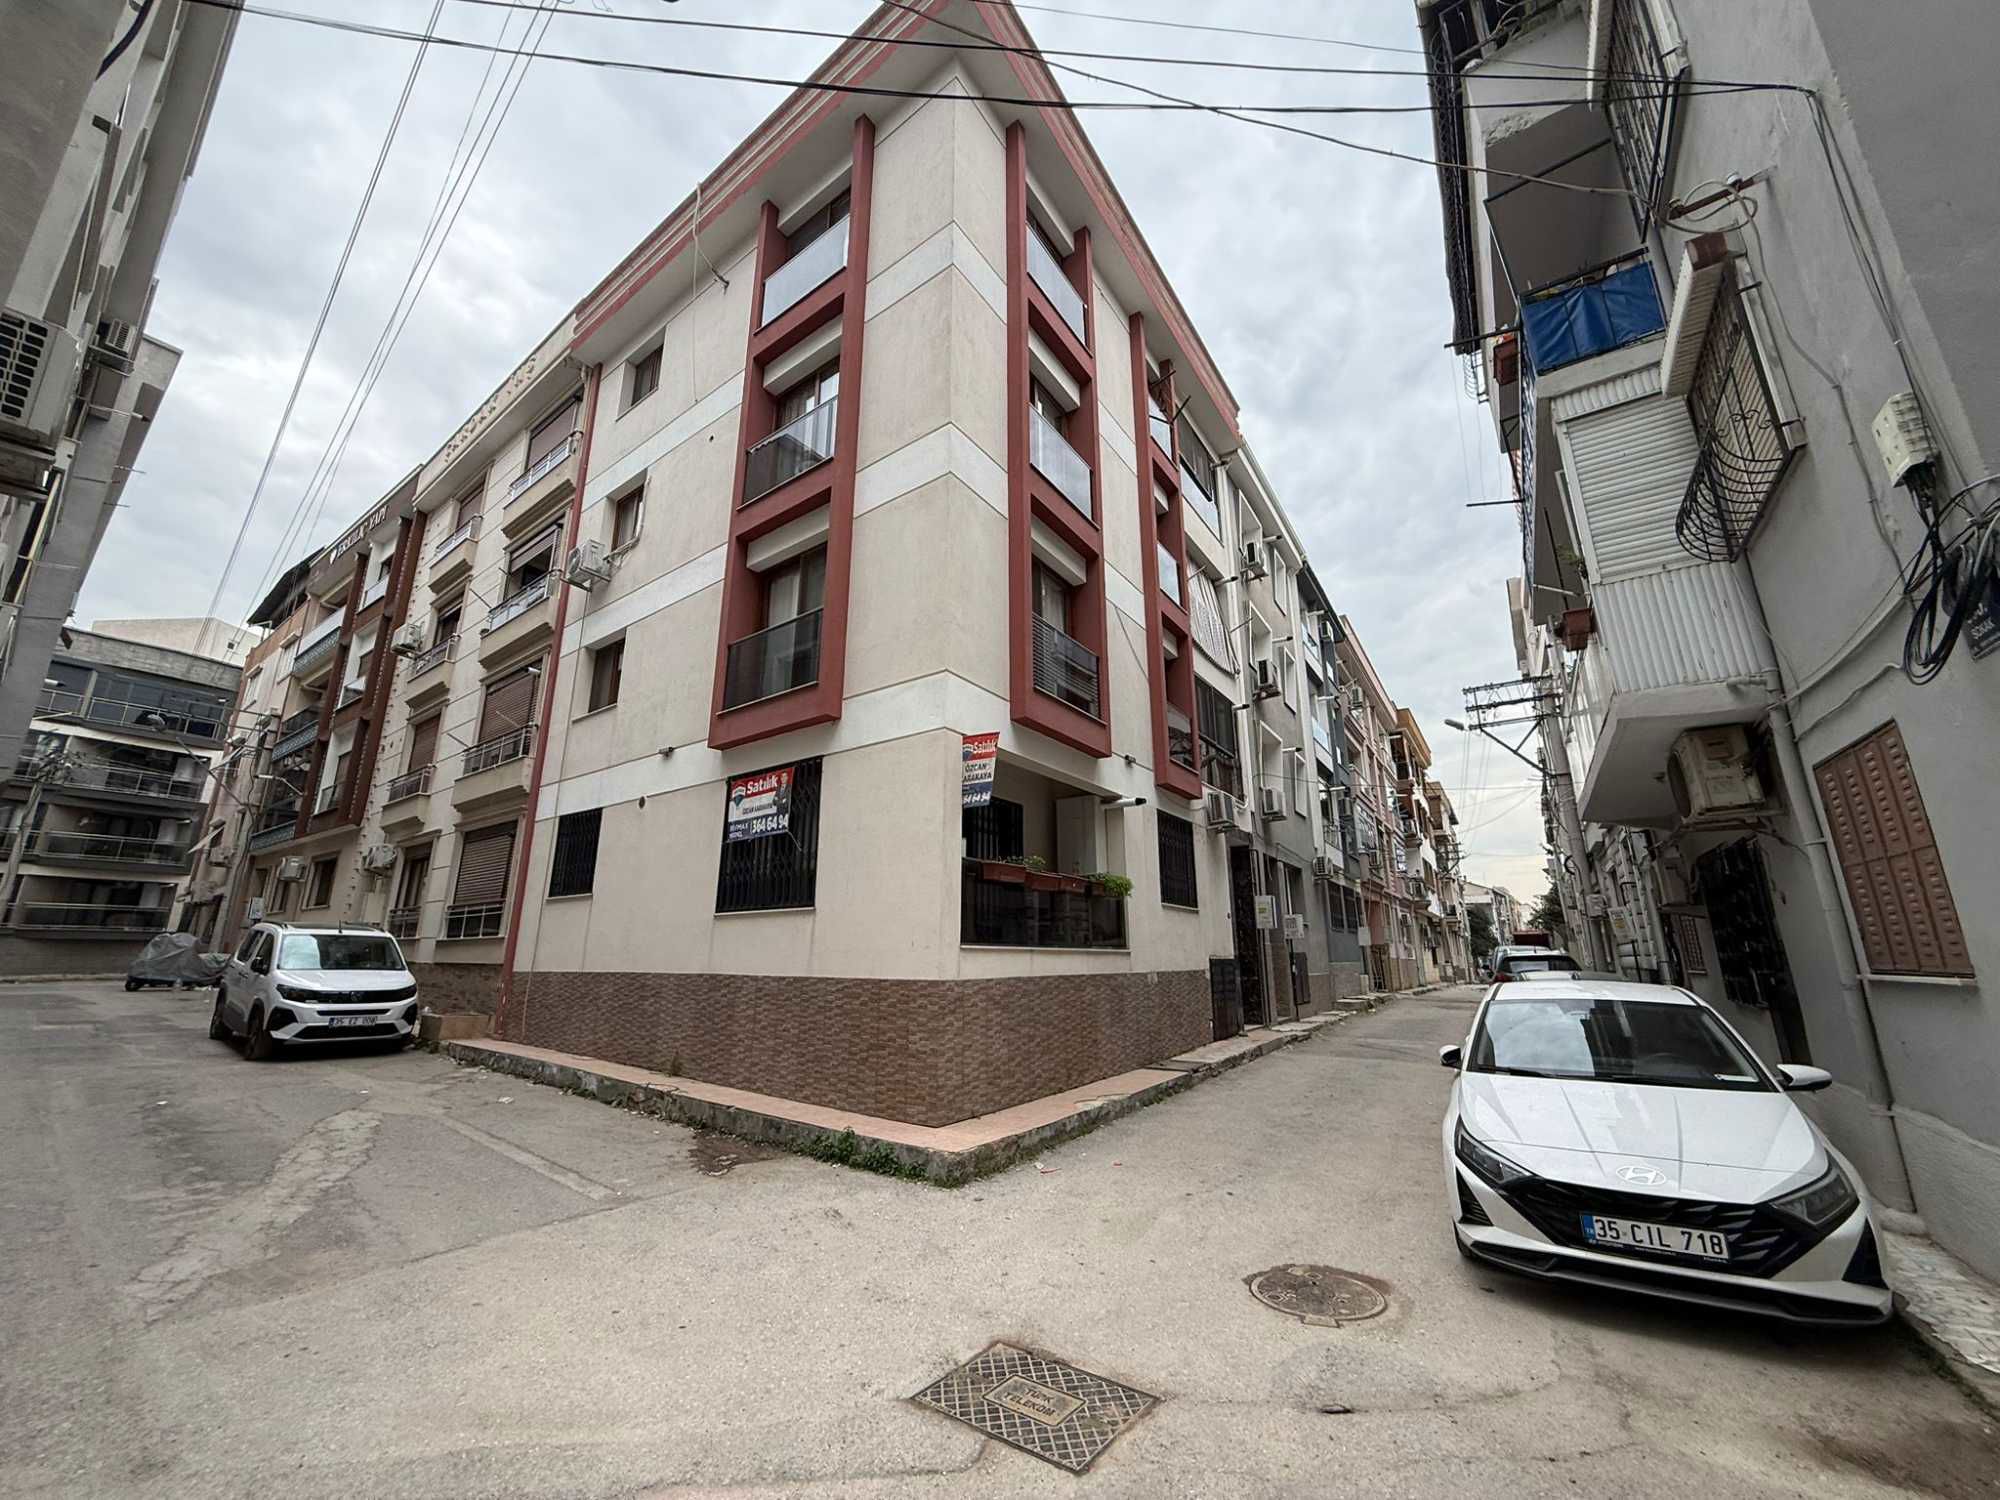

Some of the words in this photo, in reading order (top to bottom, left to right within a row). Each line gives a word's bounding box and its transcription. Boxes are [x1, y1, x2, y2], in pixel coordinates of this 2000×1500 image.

[747, 775, 778, 794] Satılık
[1595, 1219, 1620, 1239] 35
[1630, 1224, 1671, 1248] CIL
[1681, 1230, 1723, 1255] 718
[1004, 1392, 1056, 1416] TELEKOM
